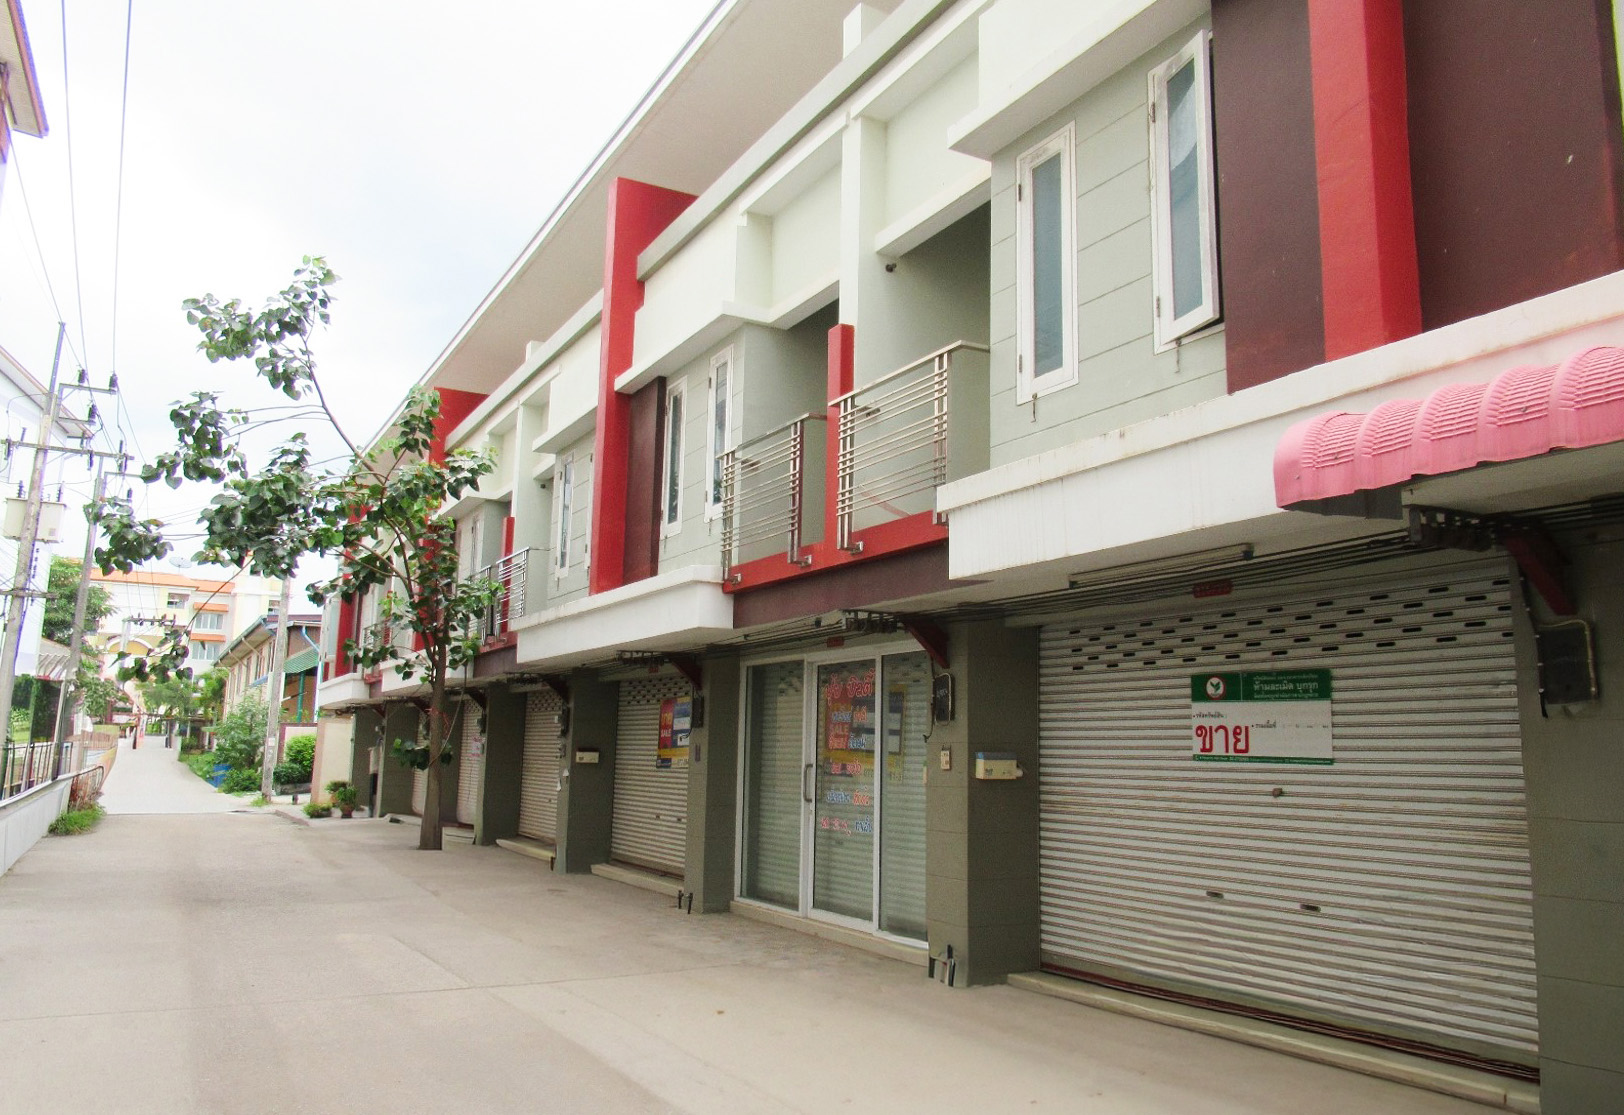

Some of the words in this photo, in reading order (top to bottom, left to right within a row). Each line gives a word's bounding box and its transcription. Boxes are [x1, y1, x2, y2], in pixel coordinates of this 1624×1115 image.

[1253, 681, 1294, 691] ห้ามละเมิด
[1297, 683, 1318, 692] บุกรุก
[1195, 725, 1249, 753] ขาย
